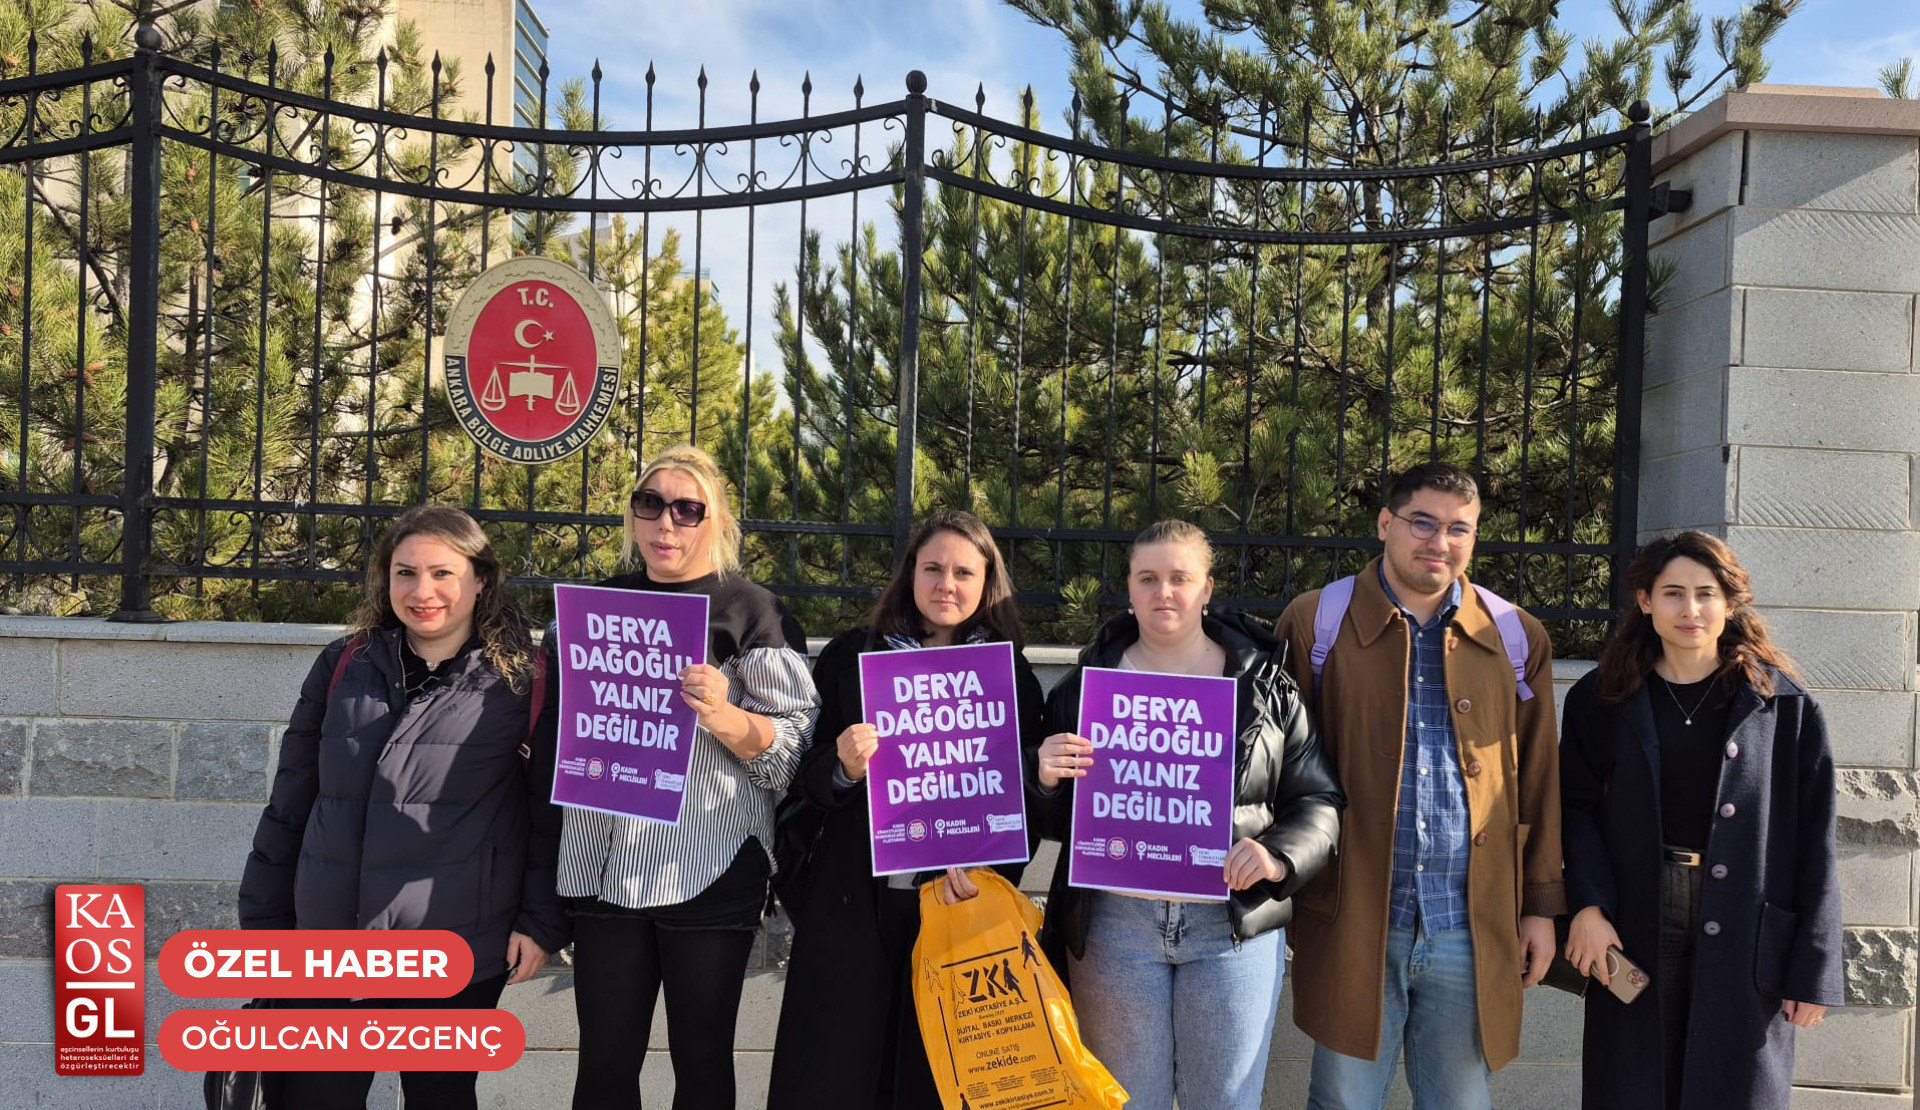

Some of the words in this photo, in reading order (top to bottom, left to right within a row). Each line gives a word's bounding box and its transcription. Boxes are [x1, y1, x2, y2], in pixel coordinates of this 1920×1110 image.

[517, 287, 554, 308] T.C.
[446, 358, 472, 417] ANKARA
[468, 416, 511, 456] BÖLGE
[512, 443, 566, 461] ADLİYE
[568, 366, 619, 447] MAHKEMESİ
[586, 613, 673, 647] DERYA
[590, 680, 673, 714] YALNIZ
[893, 670, 984, 703] DERYA
[876, 698, 1005, 738] DAĞOĞLU
[1113, 693, 1202, 725] DERYA
[576, 711, 679, 751] DEĞİLDİR
[1091, 722, 1222, 757] DAĞOĞLU
[899, 737, 989, 769] YALNIZ
[887, 767, 1005, 805] DEĞİLDİR
[1109, 758, 1201, 791] YALNIZ
[946, 819, 967, 827] KADIN
[1092, 790, 1212, 827] DEĞİLDİR
[946, 826, 980, 836] MECLİSLERİ
[1147, 844, 1169, 852] KADIN
[1147, 853, 1182, 862] MECLİSLERİ
[956, 1024, 980, 1036] DİJİTAL
[982, 1018, 1002, 1029] BASKI
[1004, 1011, 1033, 1023] MERKEZİ
[974, 1001, 1008, 1014] KIRTASİYE
[958, 1031, 992, 1044] KIRTASİYE
[996, 1021, 1036, 1036] KOPYALAMA
[968, 1053, 1037, 1074] www.zekide.com
[976, 1047, 1000, 1059] ONLINE
[1001, 1043, 1020, 1055] SATIŞ
